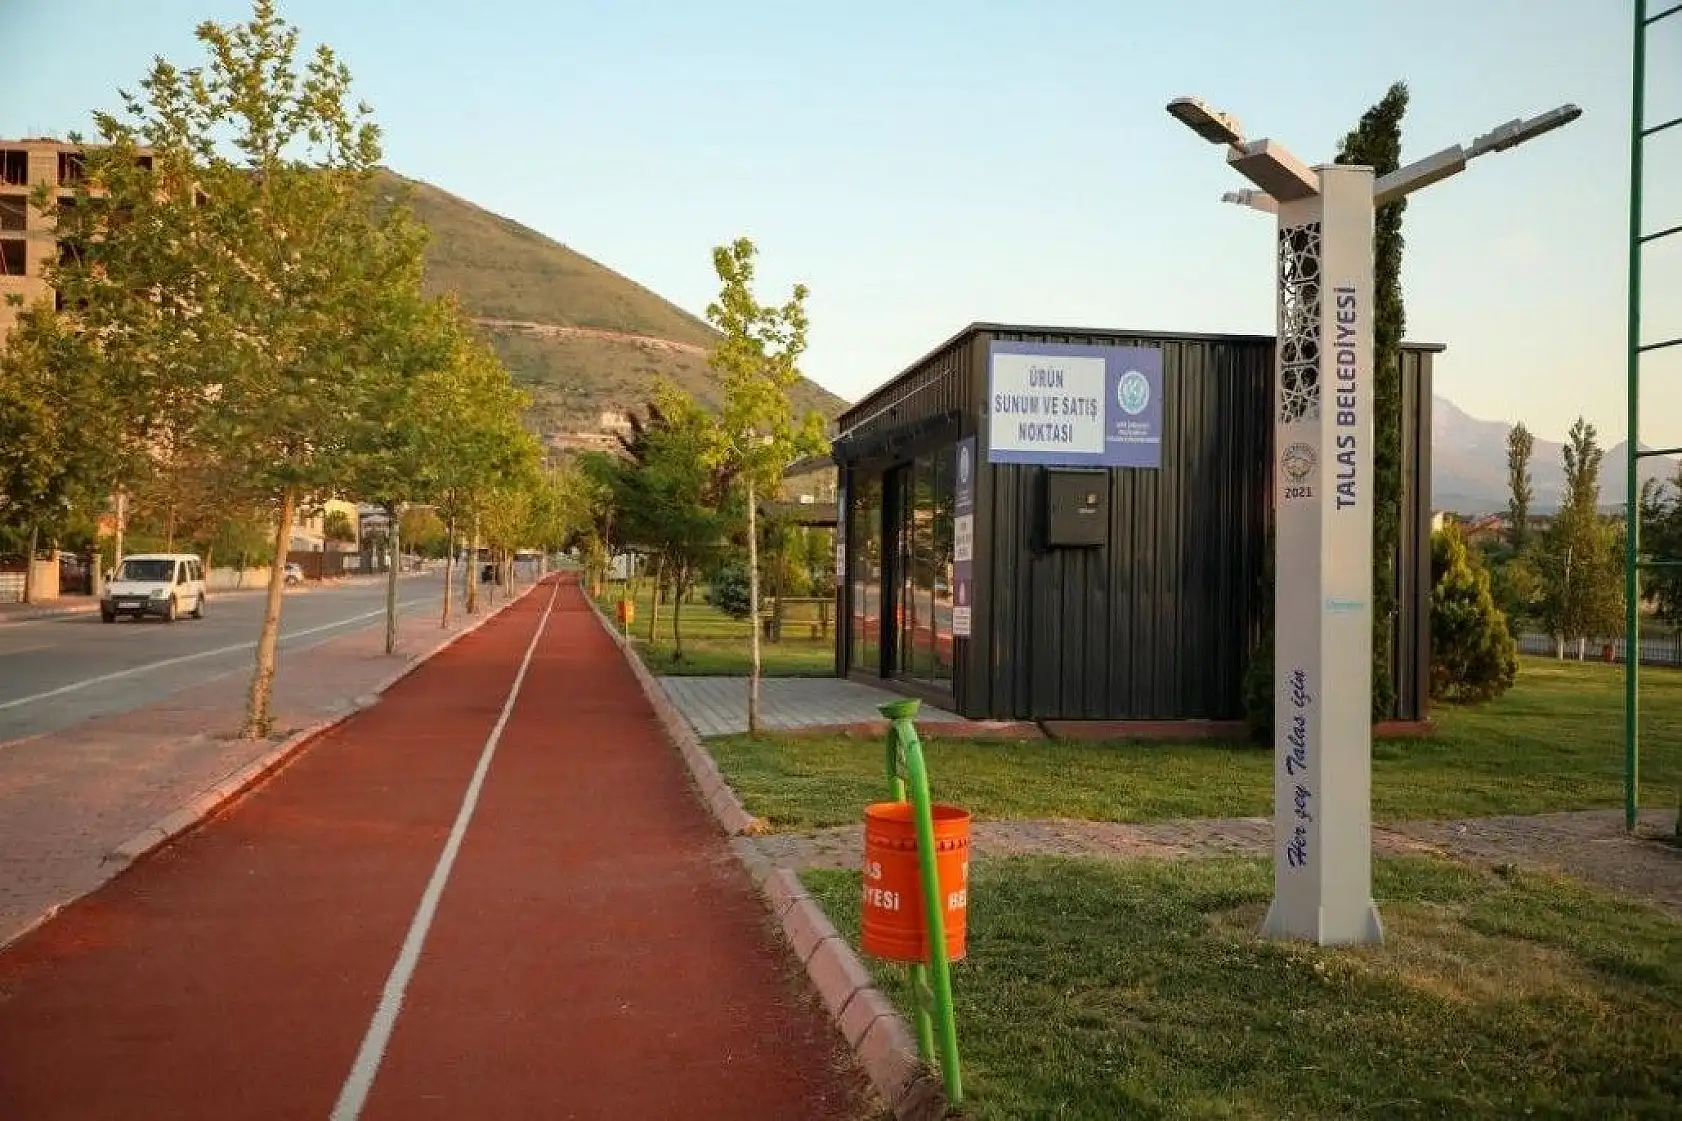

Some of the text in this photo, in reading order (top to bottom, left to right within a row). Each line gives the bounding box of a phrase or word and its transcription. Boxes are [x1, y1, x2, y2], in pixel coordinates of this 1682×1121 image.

[1029, 366, 1063, 388] ÜRÜN
[995, 394, 1098, 421] SUNUM VE SATIŞ
[1334, 286, 1356, 510] TALAS BELEDİYESİ
[1019, 423, 1073, 443] NOKTASI
[1285, 486, 1312, 498] 2021
[1290, 670, 1312, 708] için
[1286, 715, 1307, 776] Talas
[1287, 826, 1306, 867] Her
